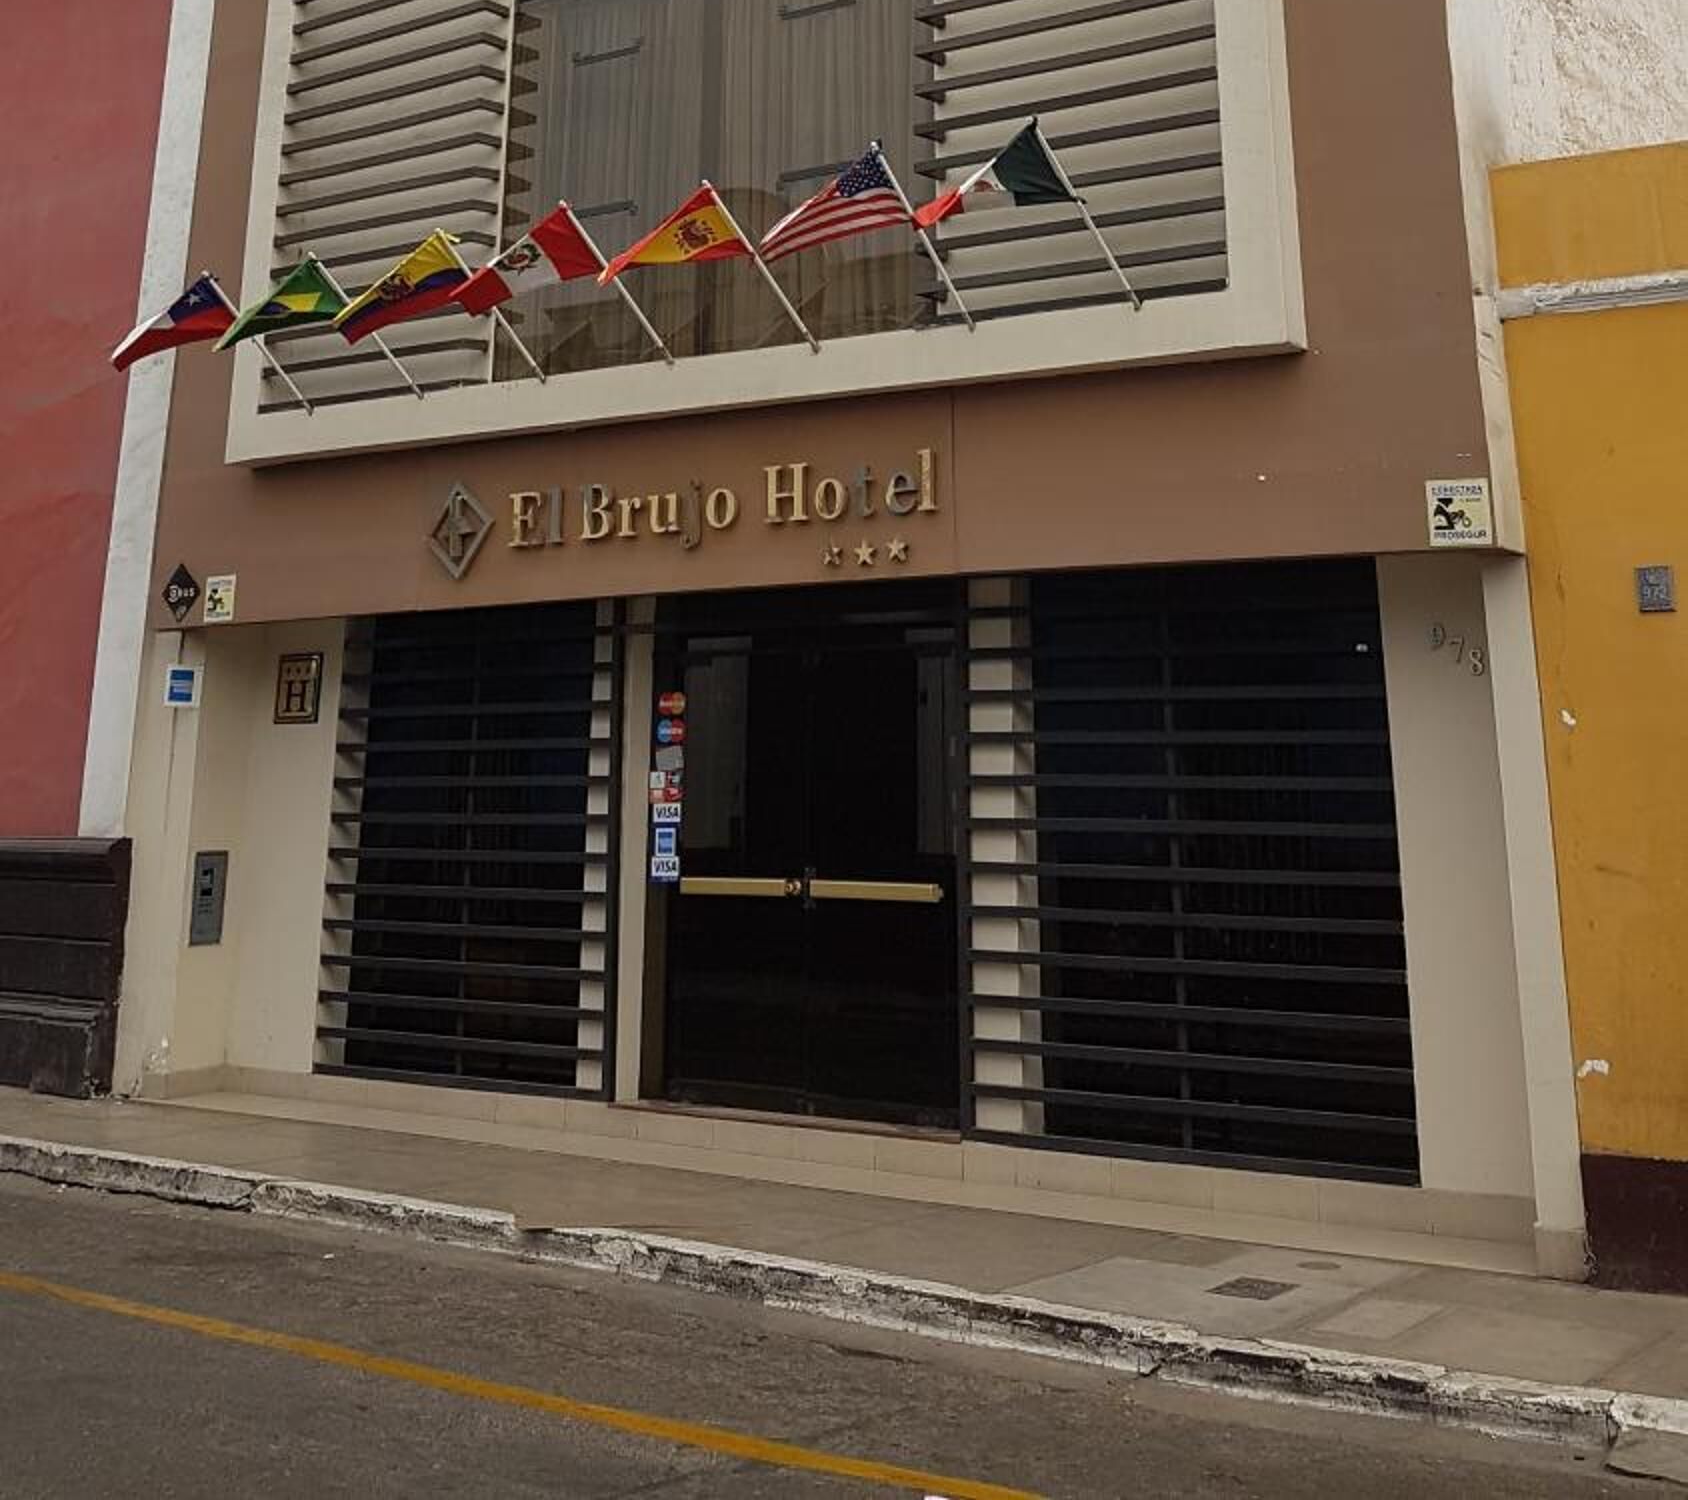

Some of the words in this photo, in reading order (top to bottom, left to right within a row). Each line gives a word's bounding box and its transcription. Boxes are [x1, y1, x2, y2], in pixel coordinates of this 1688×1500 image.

[507, 484, 565, 549] El
[580, 481, 738, 549] Brujo
[763, 446, 939, 525] Hotel
[1431, 484, 1483, 495] ECTDA
[1429, 622, 1486, 677] 978
[283, 680, 311, 713] H
[655, 806, 680, 819] VISA
[653, 861, 677, 873] VISA
